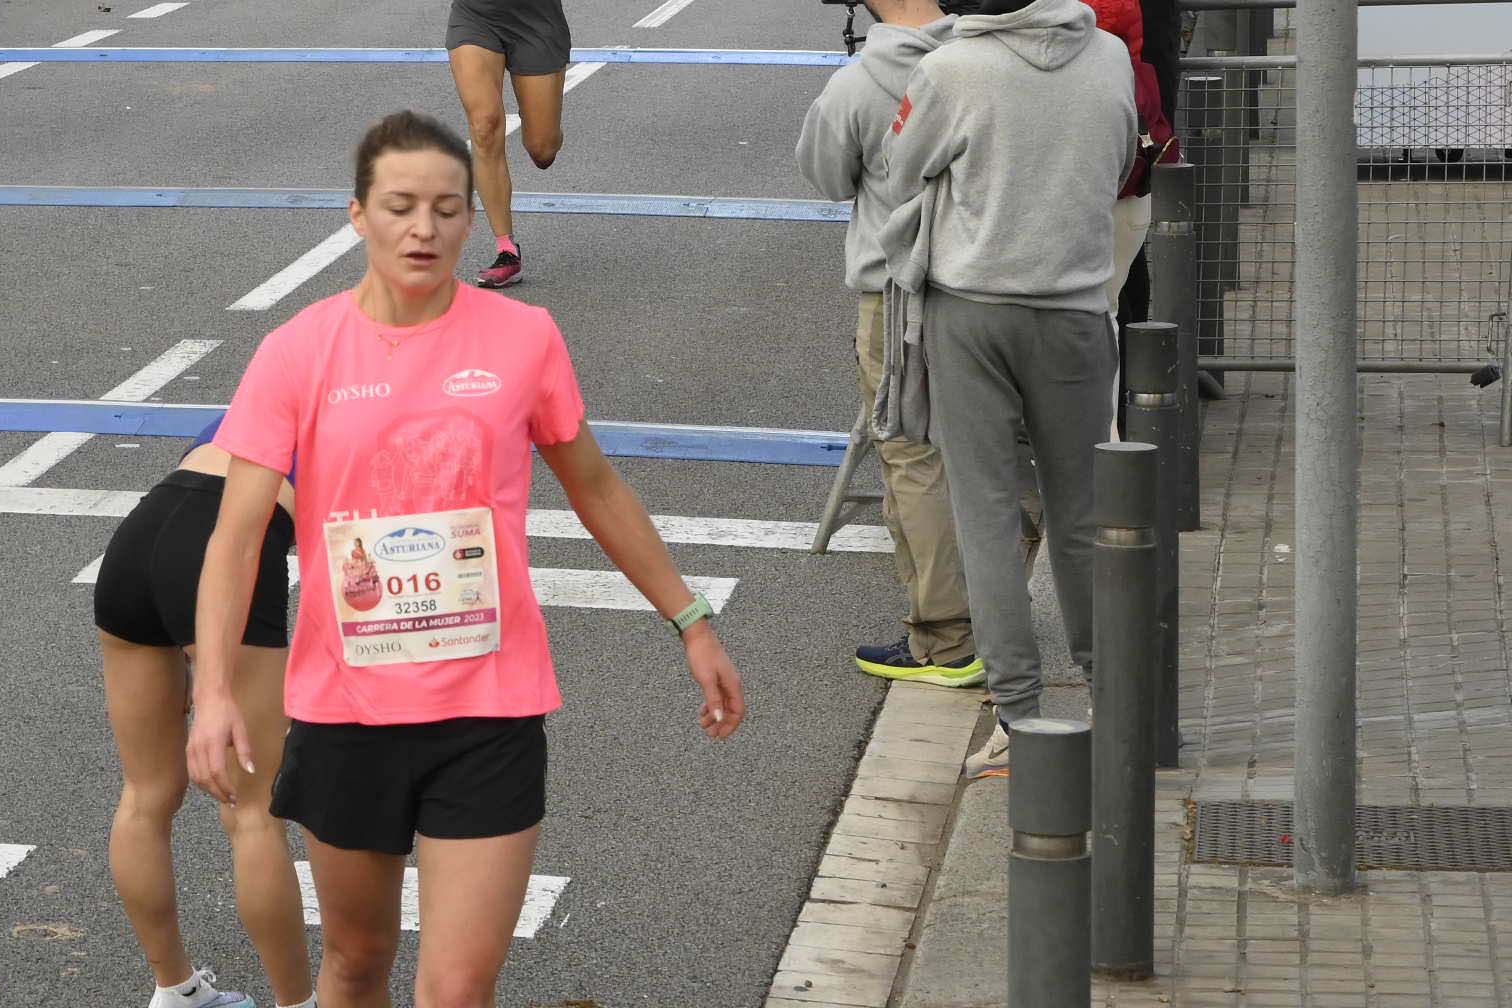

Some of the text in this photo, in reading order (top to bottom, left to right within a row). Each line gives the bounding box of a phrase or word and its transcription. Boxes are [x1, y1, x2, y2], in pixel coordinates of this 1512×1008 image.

[327, 382, 391, 405] OYSHO
[379, 539, 441, 556] ASTURIANA
[387, 572, 442, 596] 016
[395, 599, 438, 614] 32358
[356, 620, 399, 634] CARRERA
[399, 620, 413, 630] DE
[414, 618, 428, 629] LA
[429, 615, 461, 627] MUJER
[355, 633, 491, 657] OYSHO Santander
